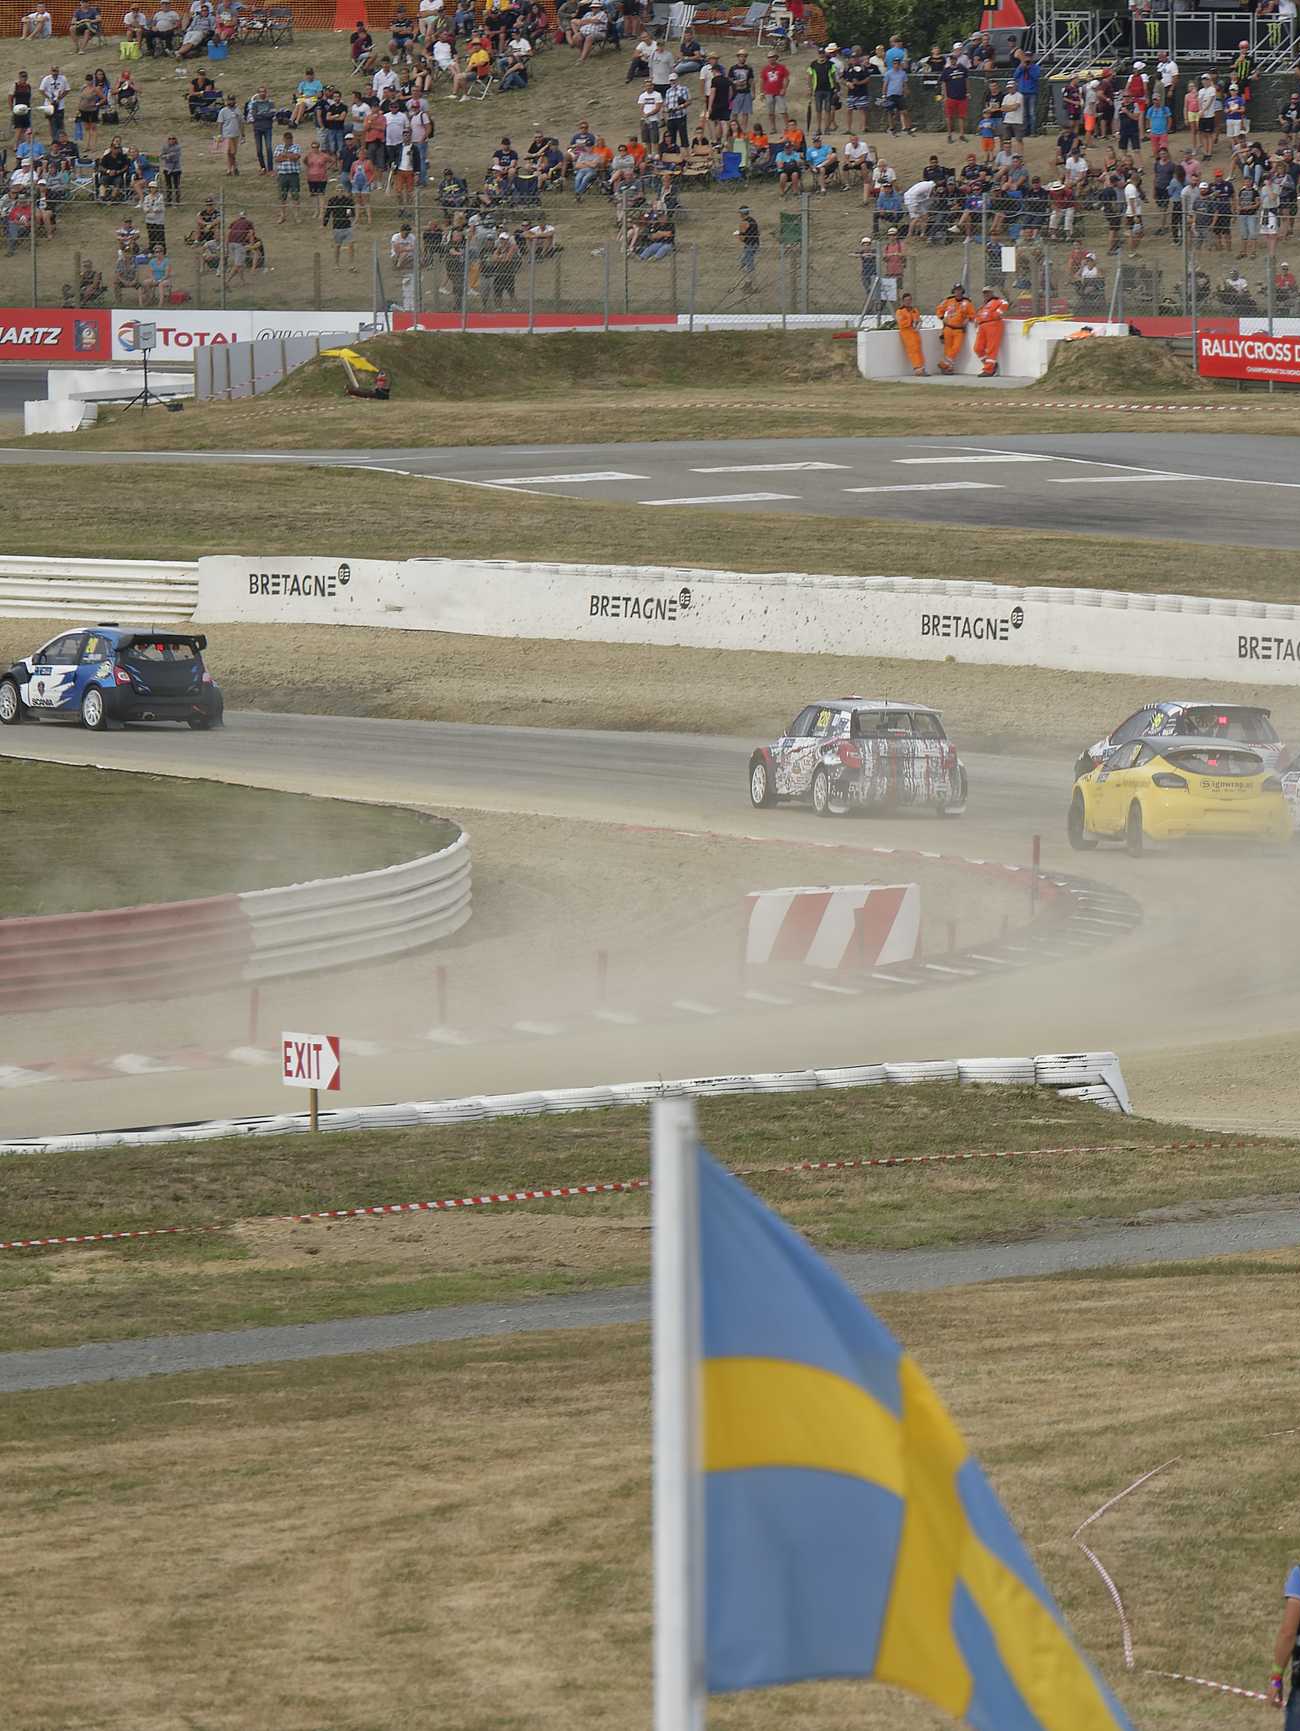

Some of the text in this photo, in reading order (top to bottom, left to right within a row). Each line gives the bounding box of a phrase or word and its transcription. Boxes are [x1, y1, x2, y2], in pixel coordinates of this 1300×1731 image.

[1202, 338, 1291, 361] RALLYCROSS
[249, 573, 336, 597] BRETAGNE
[590, 595, 677, 620] BRETAGNE
[921, 614, 1009, 640] BRETAGNE
[284, 1041, 322, 1080] EXIT
